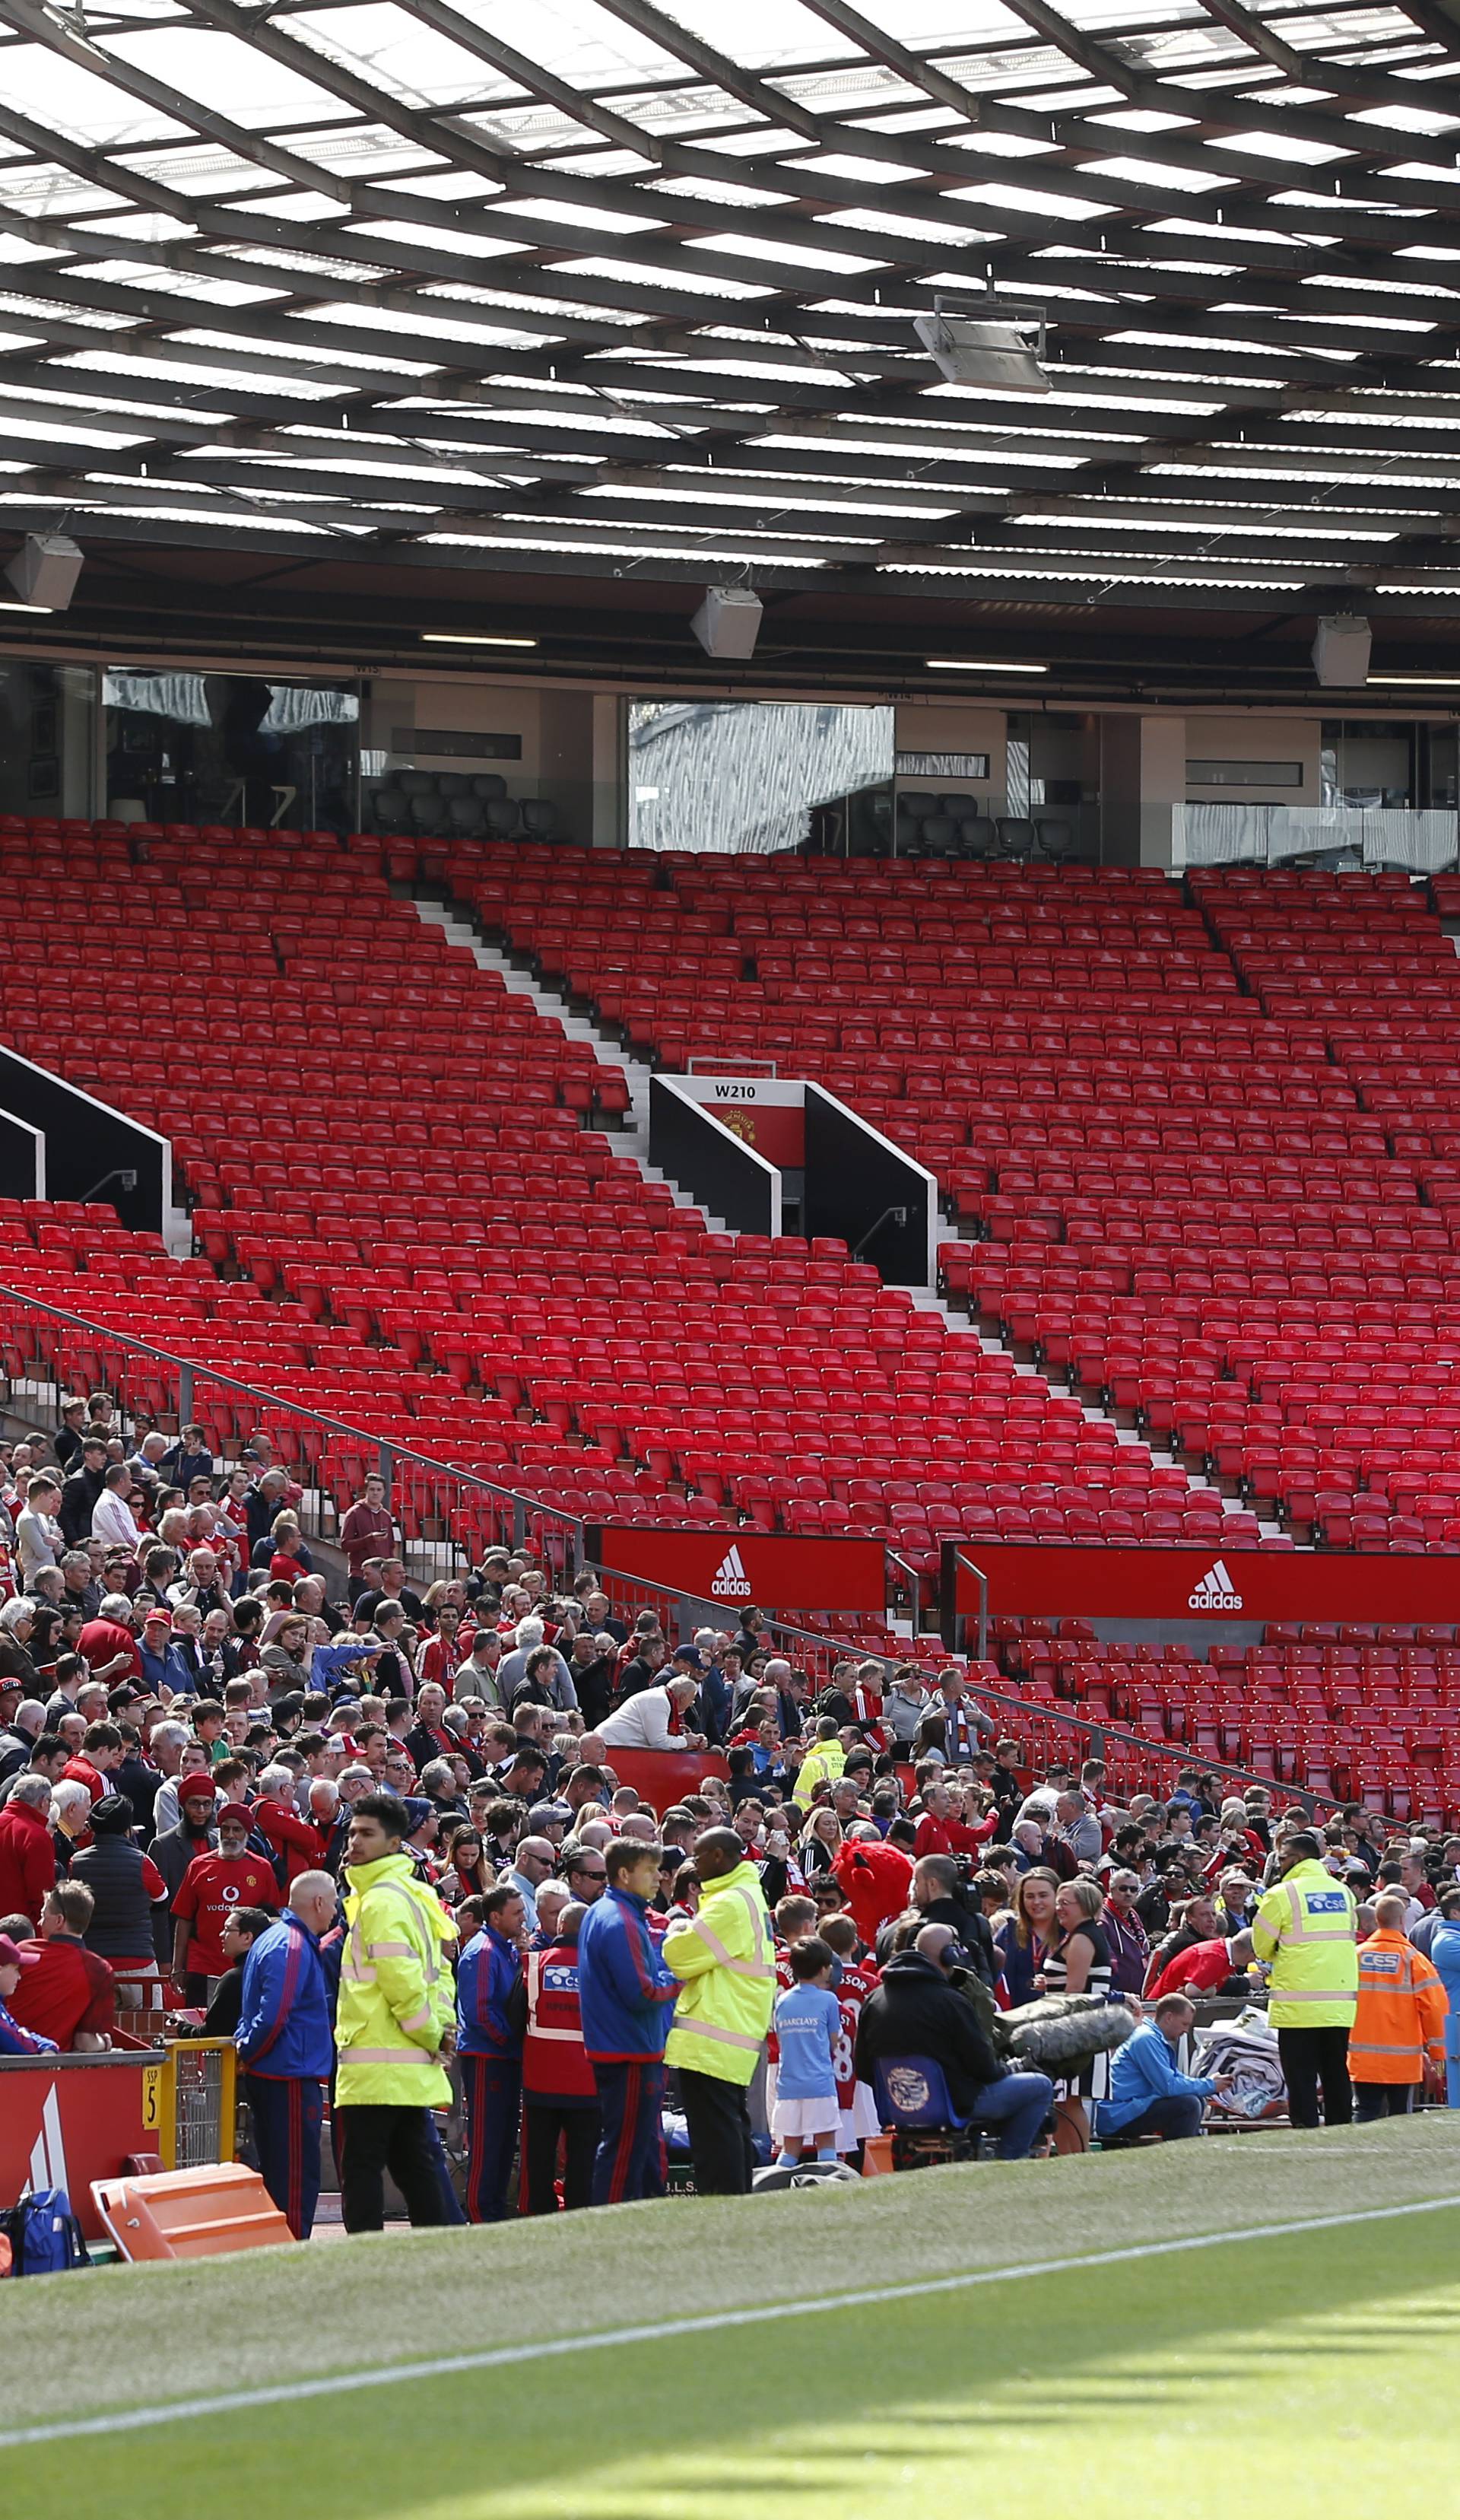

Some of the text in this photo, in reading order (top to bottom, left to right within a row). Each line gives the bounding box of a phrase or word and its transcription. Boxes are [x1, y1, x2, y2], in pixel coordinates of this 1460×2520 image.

[716, 1085, 755, 1098] W210
[711, 1577, 751, 1596] adidas
[1188, 1590, 1243, 1610] adidas
[1361, 1953, 1398, 1967] CES
[565, 1976, 580, 1988] CS
[833, 2034, 853, 2083] 8
[147, 2069, 158, 2084] SSP
[148, 2086, 156, 2123] 5
